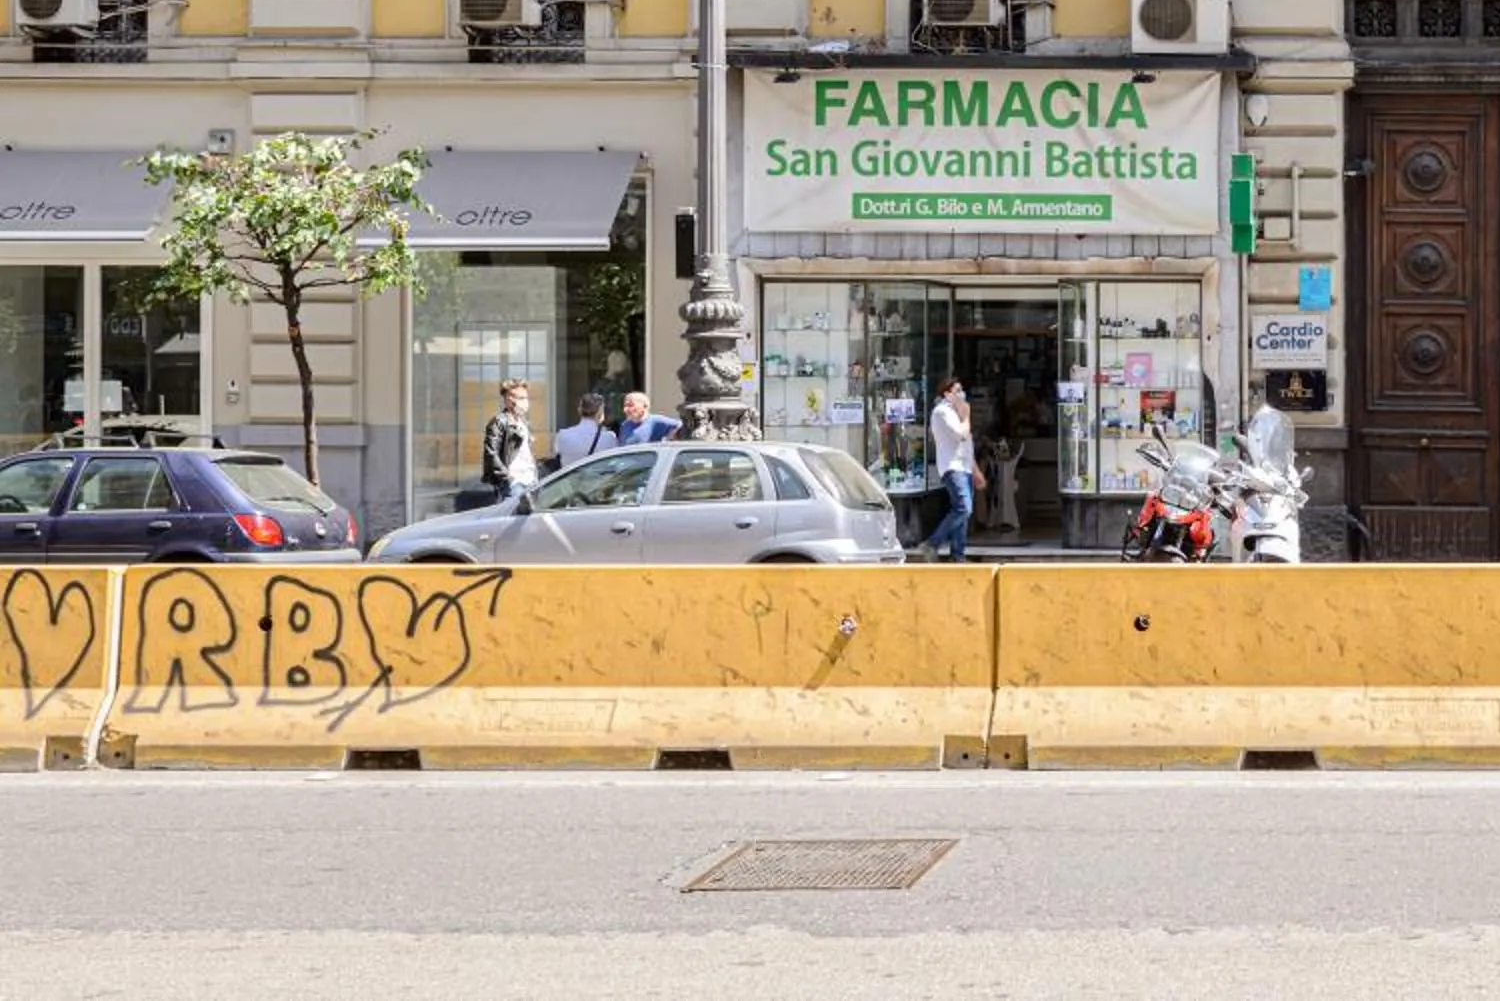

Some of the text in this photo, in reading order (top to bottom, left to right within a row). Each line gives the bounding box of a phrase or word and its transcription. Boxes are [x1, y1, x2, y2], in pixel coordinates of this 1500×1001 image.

[814, 78, 1148, 130] FARMACIA
[765, 139, 1199, 181] San Giovanni Battista
[0, 201, 75, 221] oltre
[456, 206, 532, 226] oltre
[860, 198, 911, 216] Dott.ri
[915, 199, 933, 216] G.
[972, 201, 983, 216] e
[987, 199, 1007, 216] M.
[1011, 200, 1103, 217] Armentano
[1266, 322, 1324, 337] Cardio
[1255, 335, 1315, 350] Center
